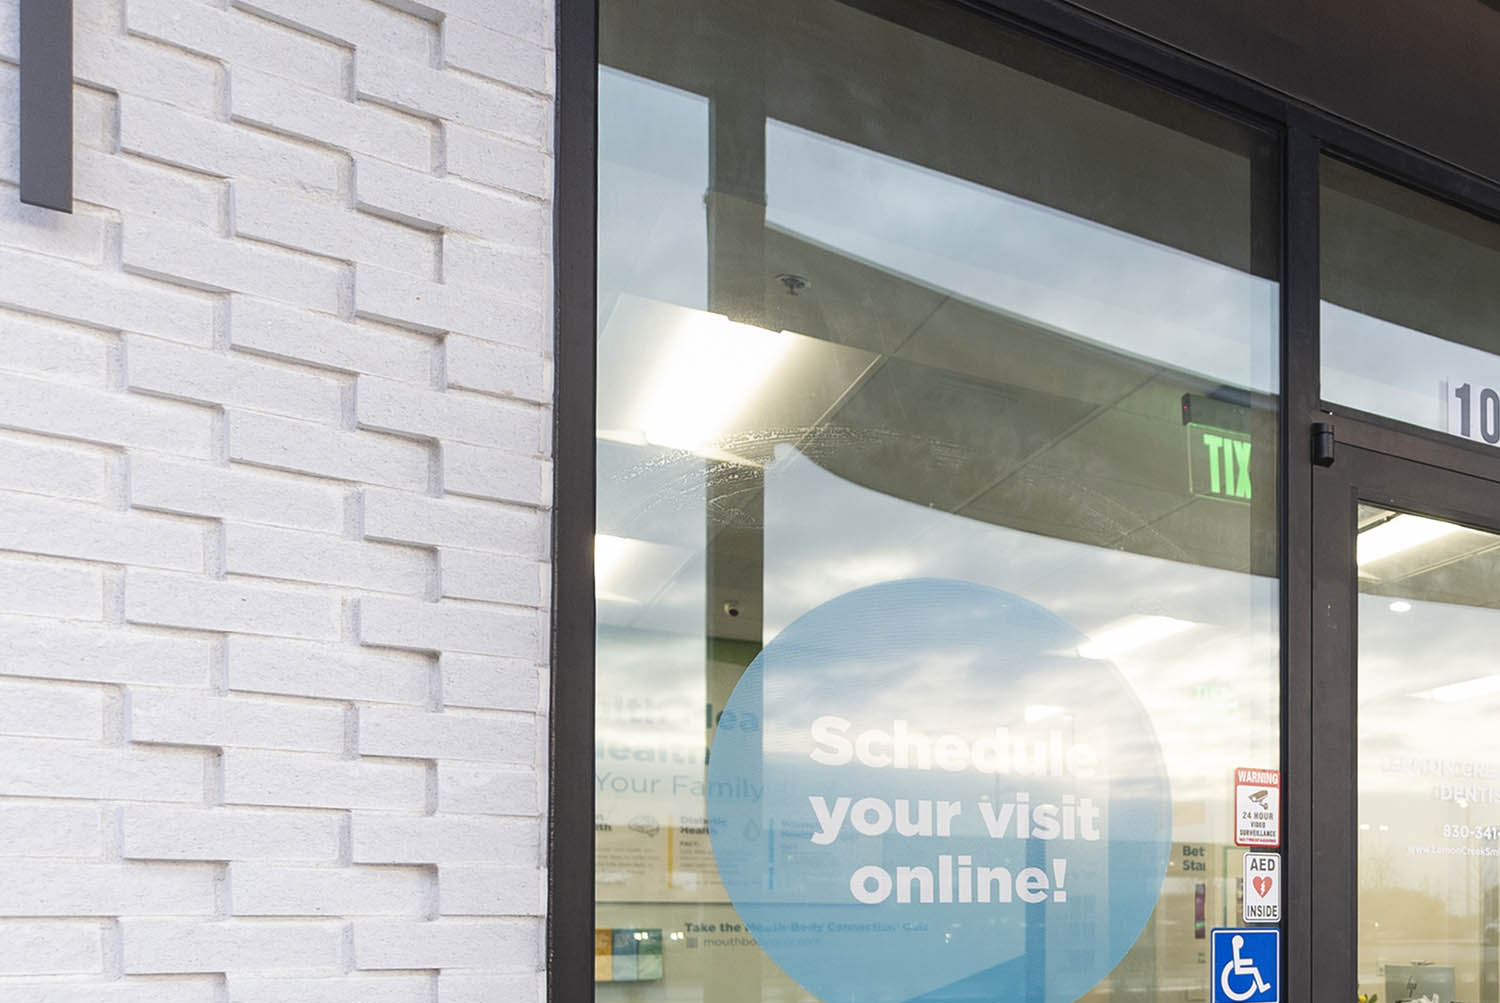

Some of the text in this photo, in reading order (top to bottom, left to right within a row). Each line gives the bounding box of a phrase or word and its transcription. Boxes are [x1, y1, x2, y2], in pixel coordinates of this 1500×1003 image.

[808, 715, 1101, 780] Schedule
[596, 771, 661, 794] Your
[1238, 770, 1278, 784] WARNING
[808, 796, 961, 845] your
[977, 791, 1100, 841] visit
[1242, 811, 1273, 820] 24 HOUR
[1250, 858, 1276, 871] AED
[850, 854, 1067, 904] online!
[1247, 905, 1277, 917] INSIDE
[684, 922, 716, 933] Take
[719, 922, 742, 933] the
